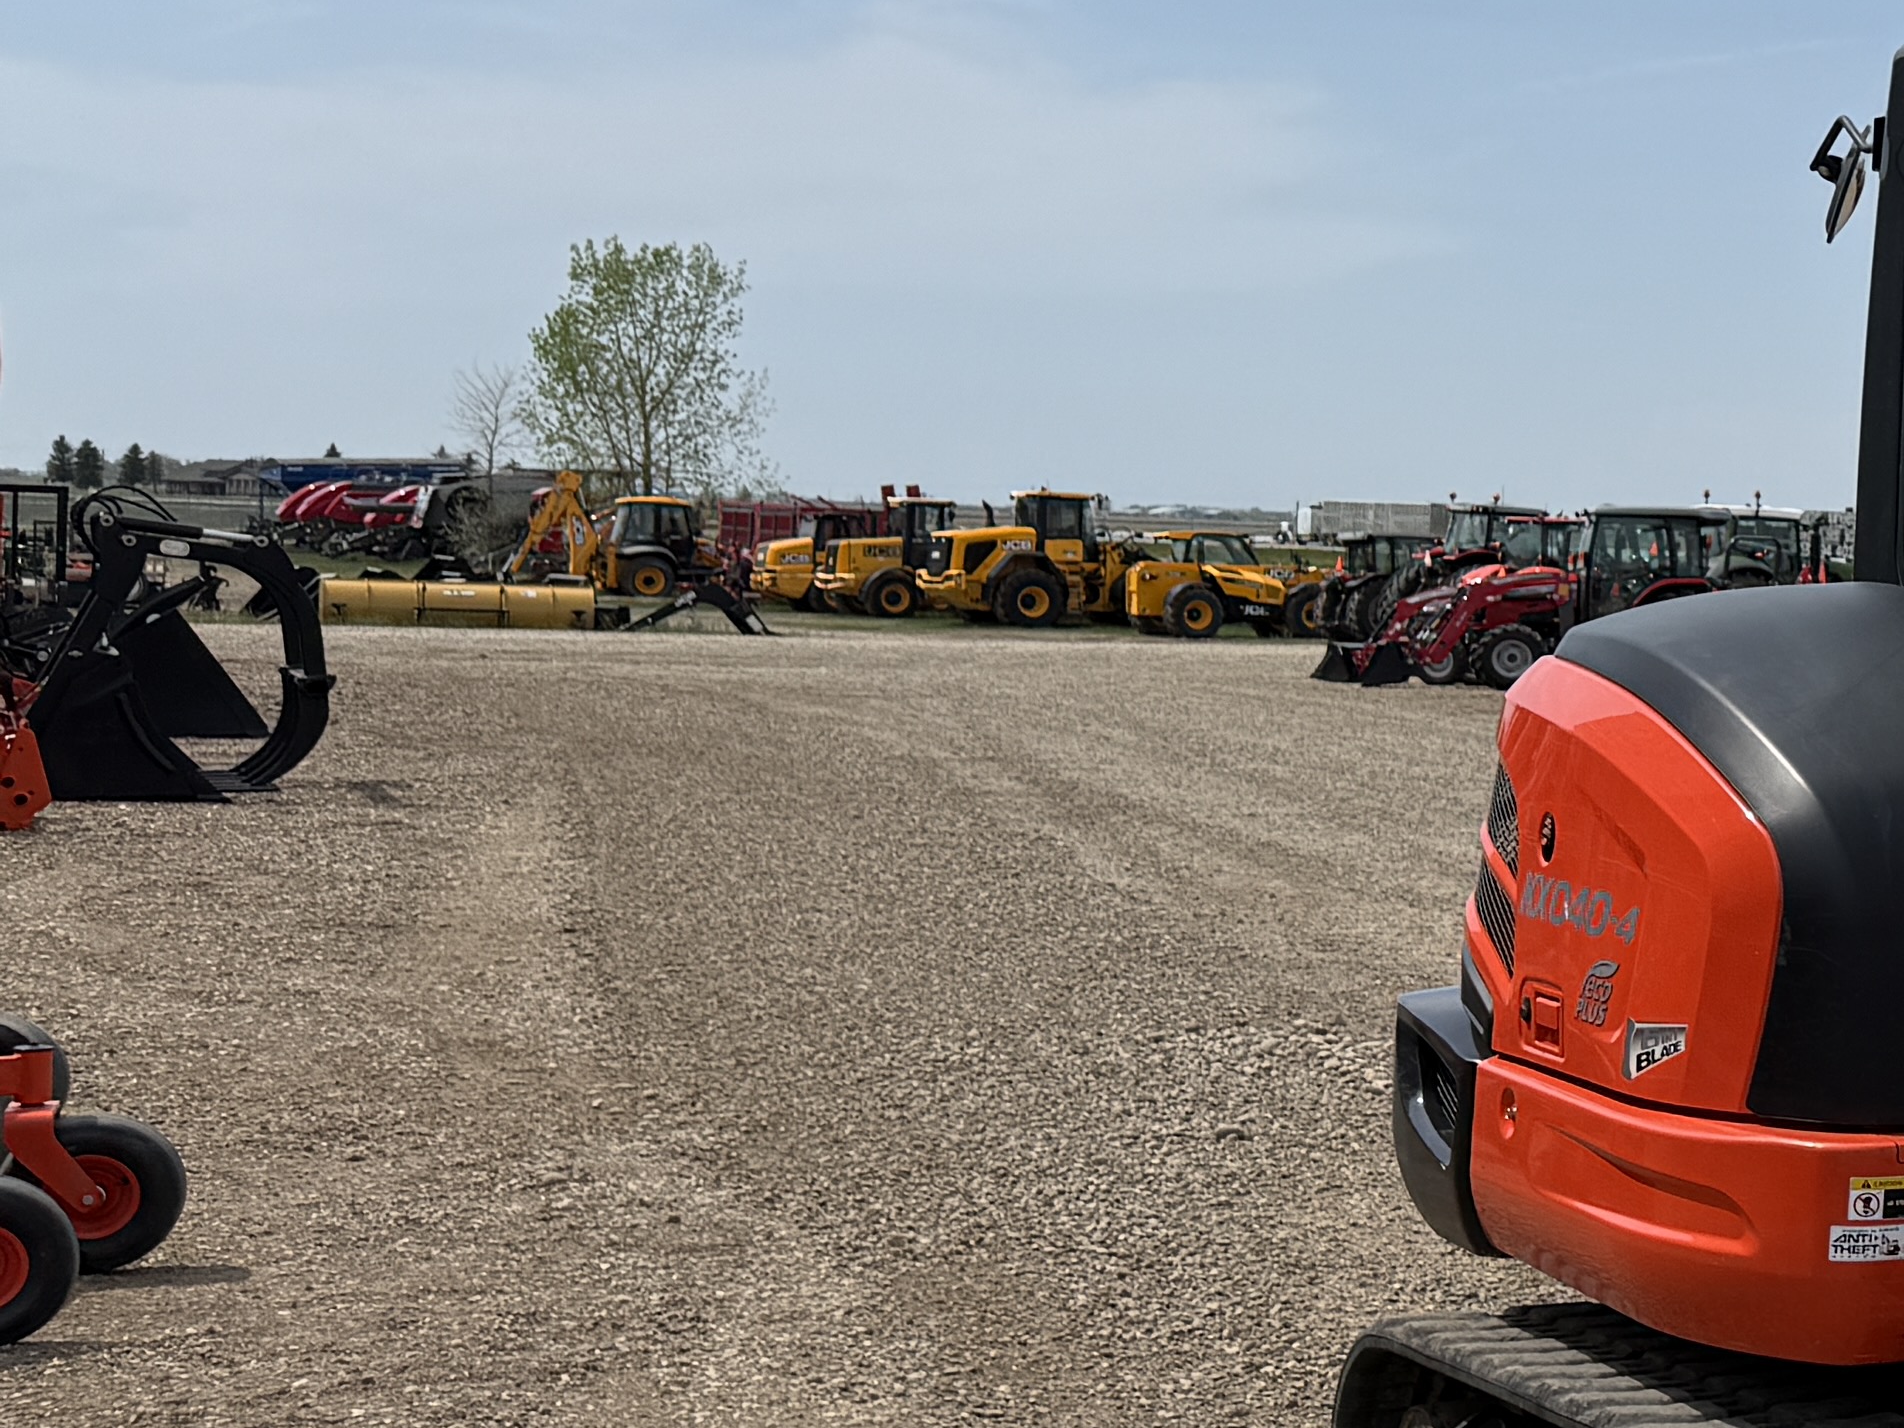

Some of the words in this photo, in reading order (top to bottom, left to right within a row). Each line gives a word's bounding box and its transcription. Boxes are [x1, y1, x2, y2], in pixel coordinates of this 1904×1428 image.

[1576, 997, 1608, 1025] PLUS
[1636, 1040, 1682, 1073] BLADE
[1831, 1244, 1880, 1254] THEFT
